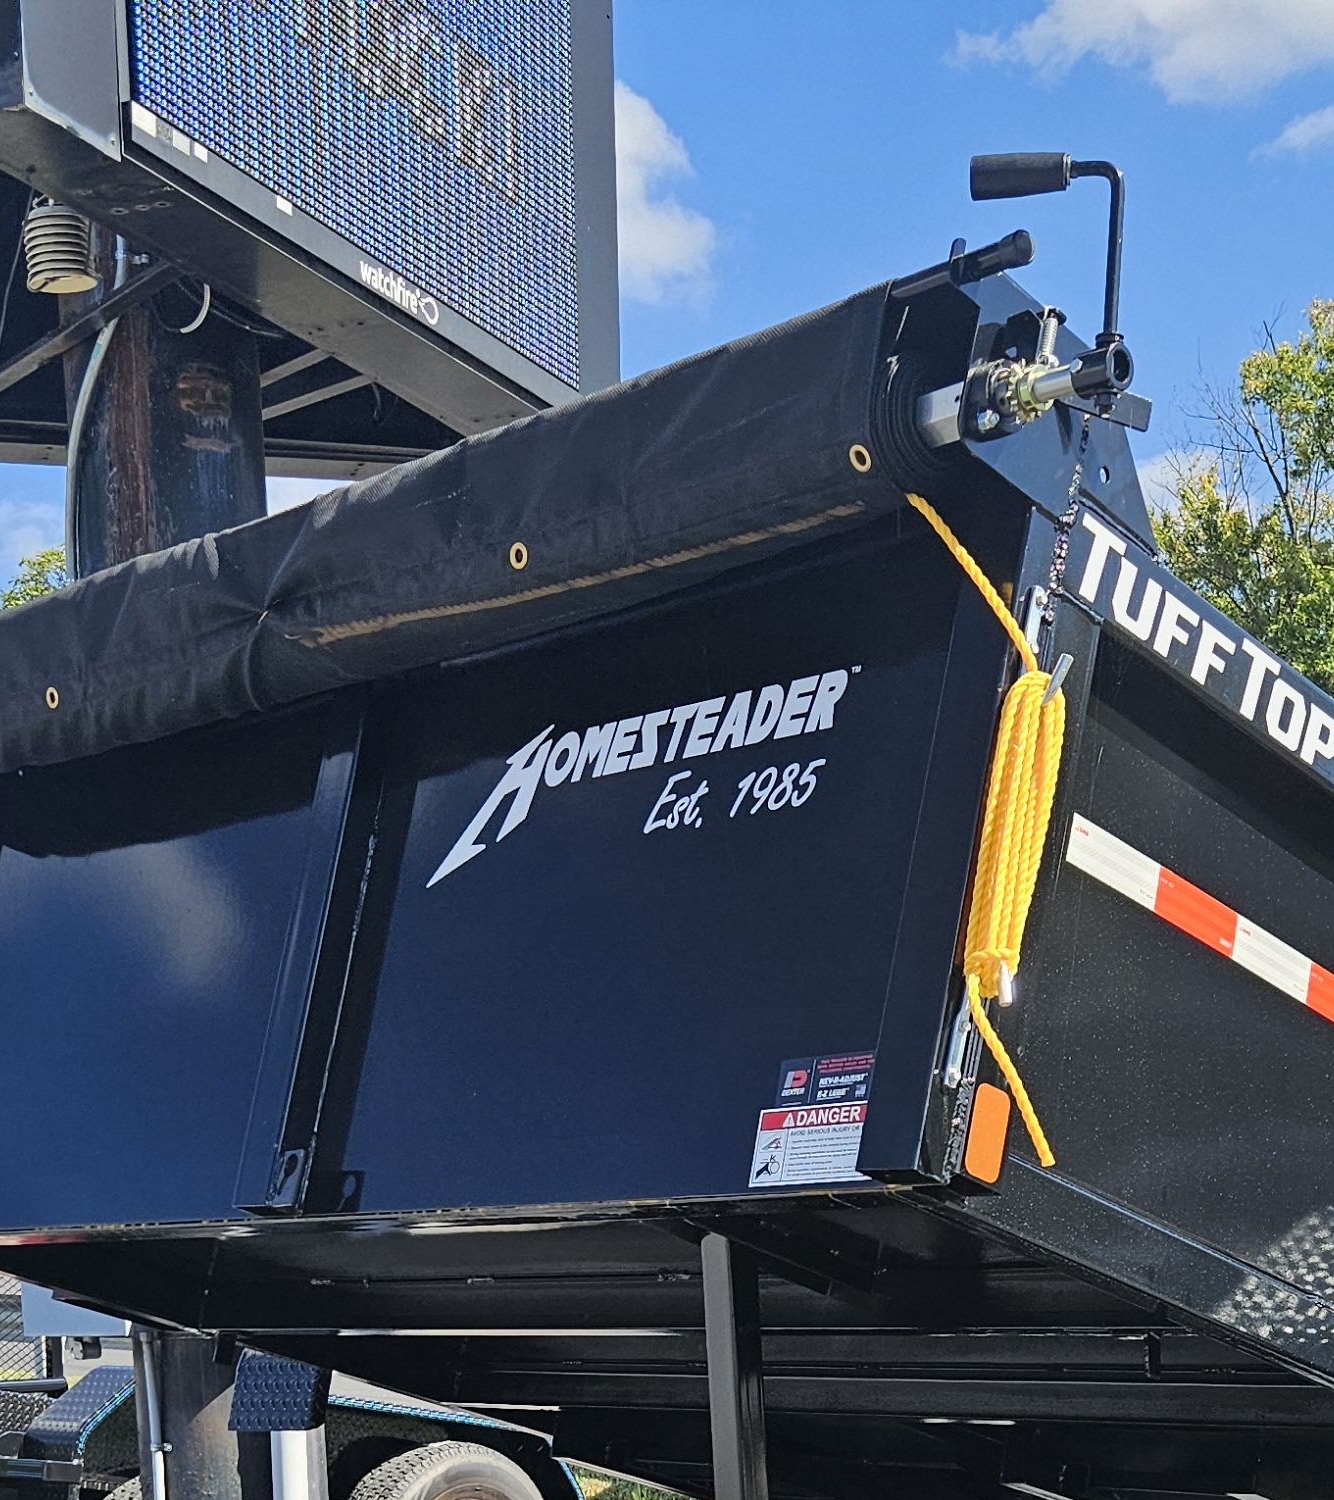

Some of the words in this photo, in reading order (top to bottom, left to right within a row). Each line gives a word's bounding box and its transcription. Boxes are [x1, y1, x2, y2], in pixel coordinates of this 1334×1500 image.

[359, 260, 419, 315] watchfire
[426, 668, 848, 888] HOMESTEADER
[643, 770, 709, 834] Est.
[730, 758, 826, 818] 1985
[790, 1128, 806, 1136] AVOID
[807, 1127, 830, 1136] SERIOUS
[832, 1126, 850, 1135] INJURY
[794, 1106, 861, 1127] DANGER
